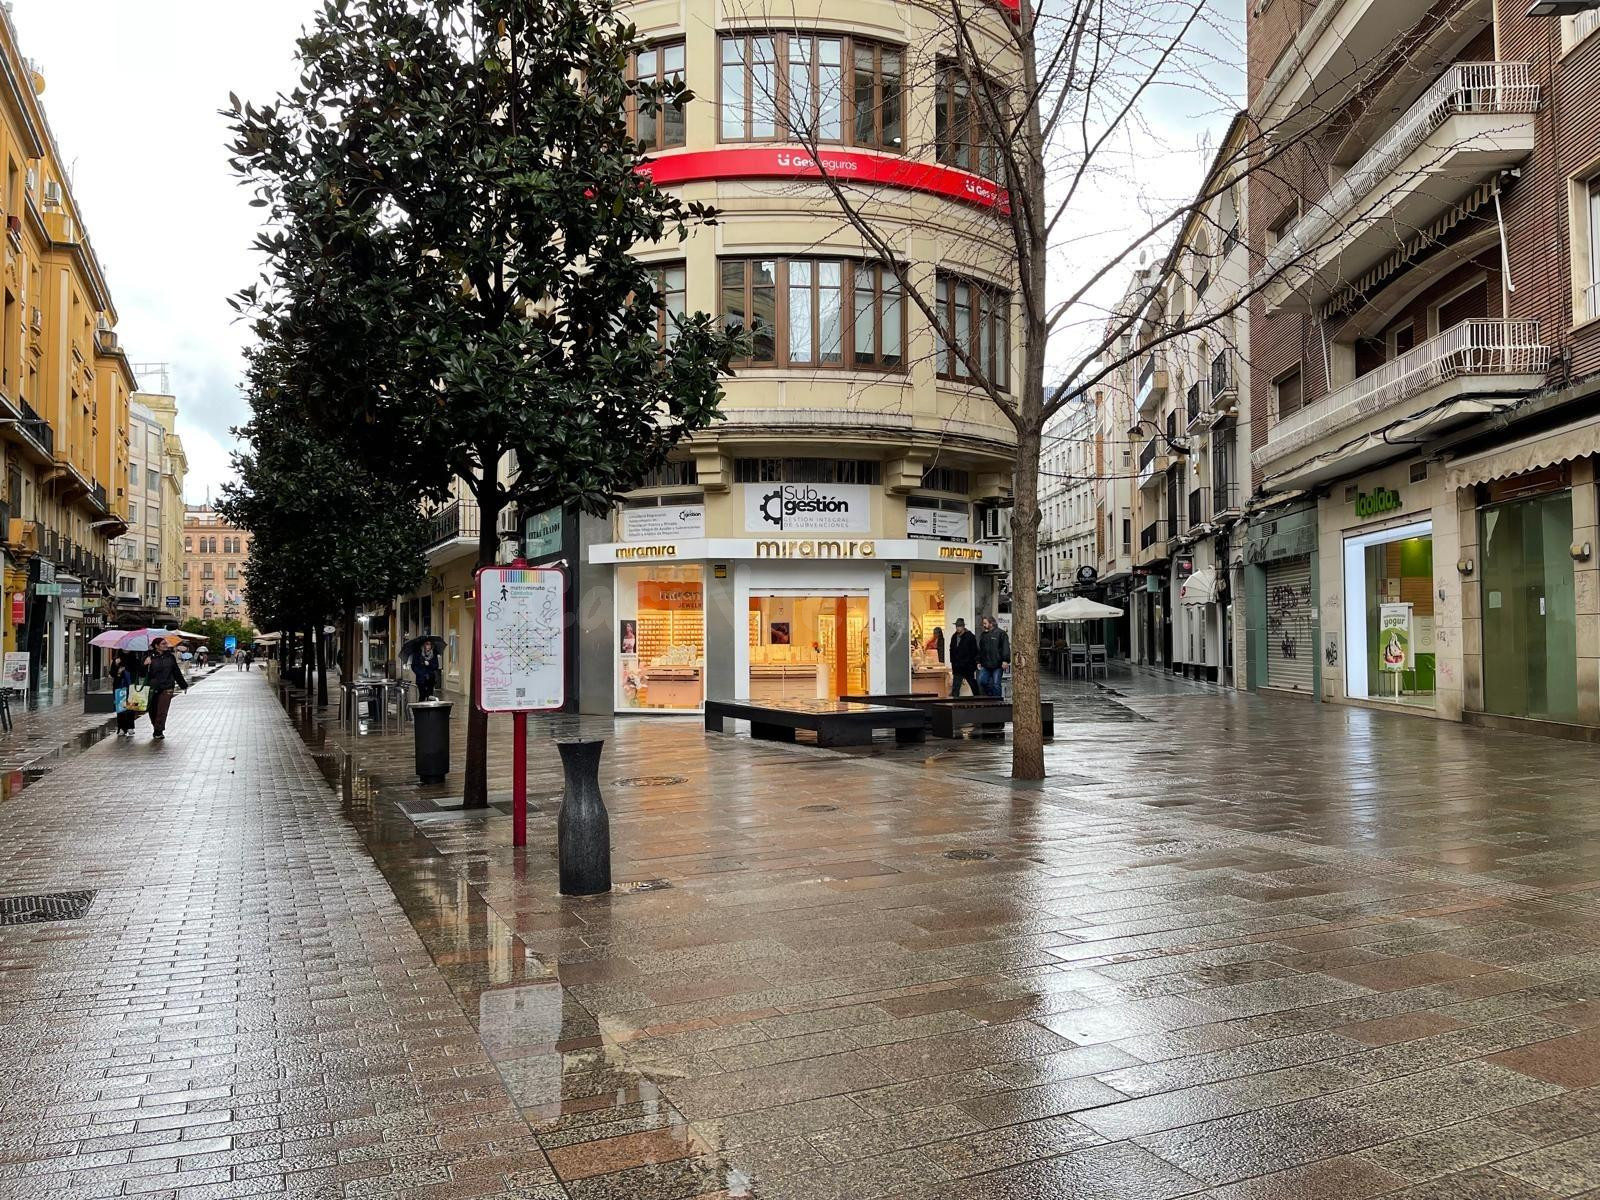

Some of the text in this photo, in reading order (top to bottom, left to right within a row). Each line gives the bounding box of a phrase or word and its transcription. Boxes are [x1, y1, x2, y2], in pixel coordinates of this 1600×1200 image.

[792, 156, 815, 168] Ges
[975, 185, 991, 199] Ges
[784, 484, 818, 501] Sub
[784, 496, 849, 516] gestión
[615, 543, 677, 559] miramira
[755, 540, 876, 559] miramira
[939, 546, 984, 561] miramira
[1383, 617, 1406, 628] yogur
